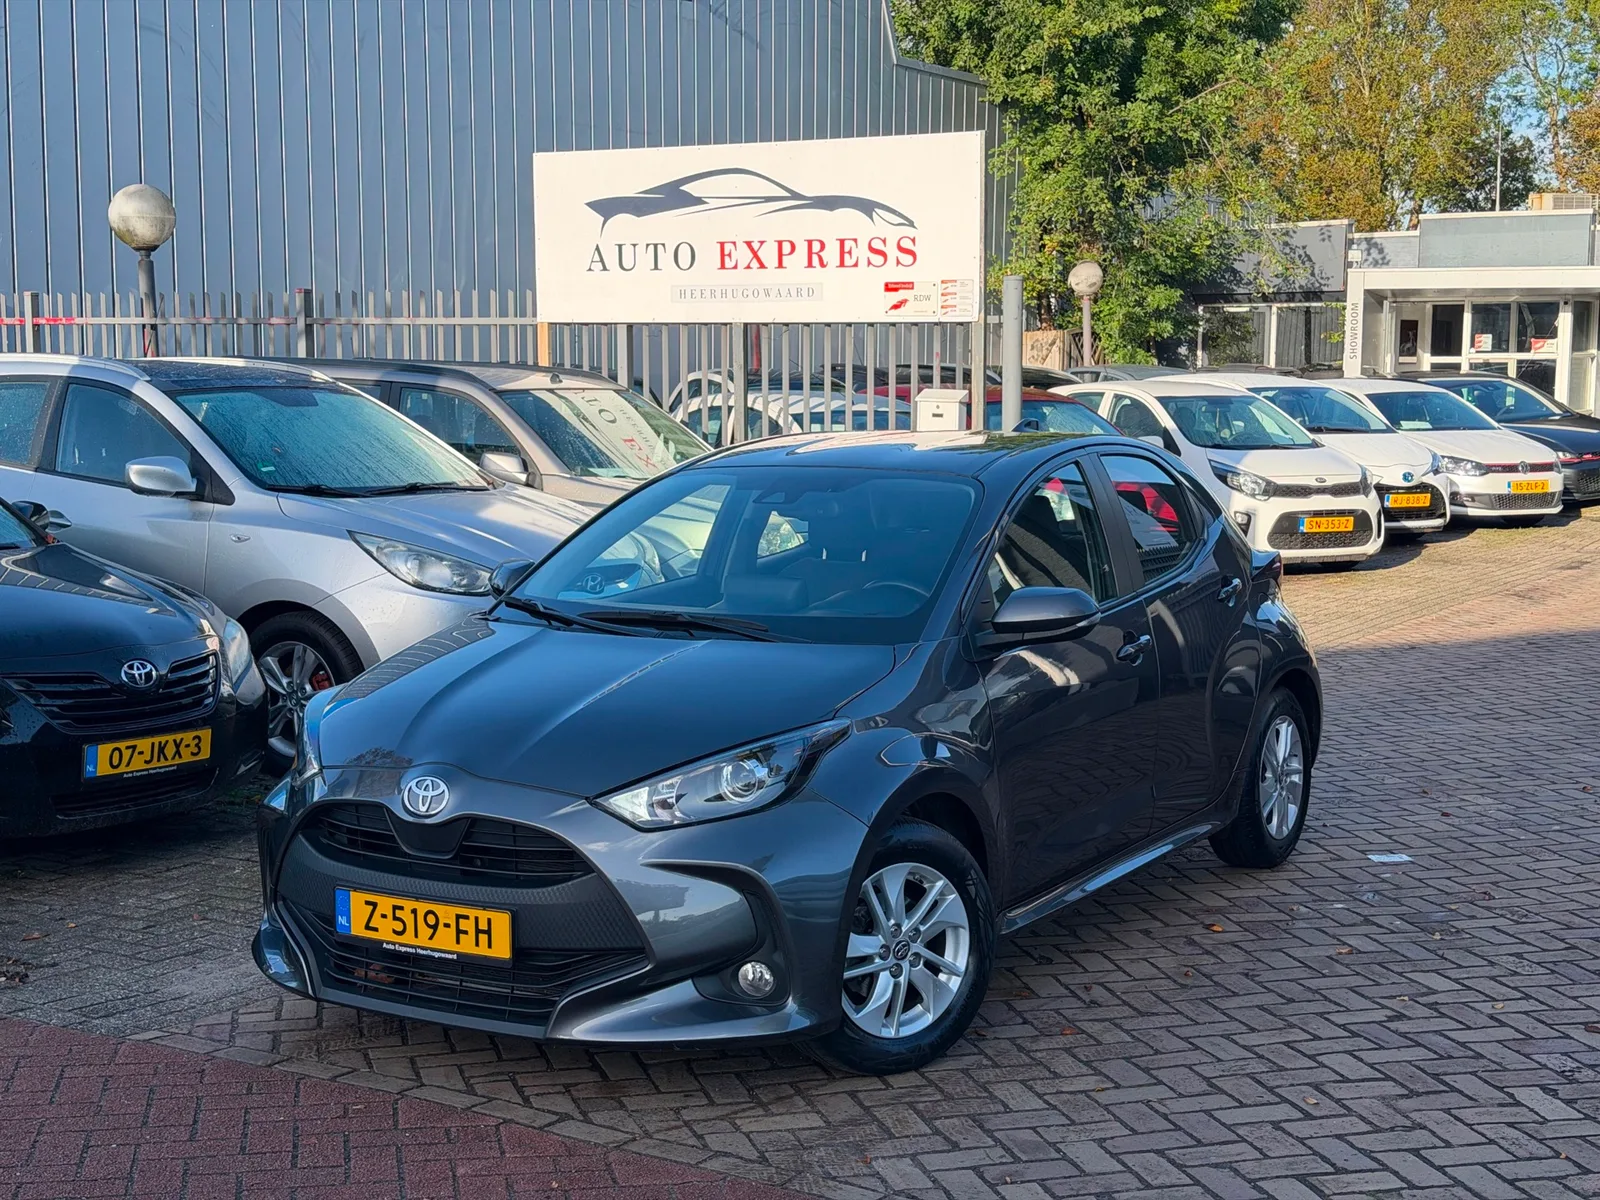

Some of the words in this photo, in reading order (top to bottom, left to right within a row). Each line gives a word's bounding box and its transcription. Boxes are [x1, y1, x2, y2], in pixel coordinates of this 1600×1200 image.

[586, 241, 697, 273] AUTO
[716, 236, 918, 271] EXPRESS
[679, 287, 815, 300] HEERHUGOWAARD
[913, 294, 932, 302] RDW
[1349, 302, 1359, 360] SHOWROOM
[1308, 520, 1350, 530] SN-353-Z
[108, 735, 202, 770] 07-JKX-3
[338, 915, 350, 926] NL
[364, 899, 493, 950] Z-519-FH
[382, 942, 395, 950] Auto
[395, 944, 416, 954] Express
[416, 948, 457, 959] Heerhugowaard
